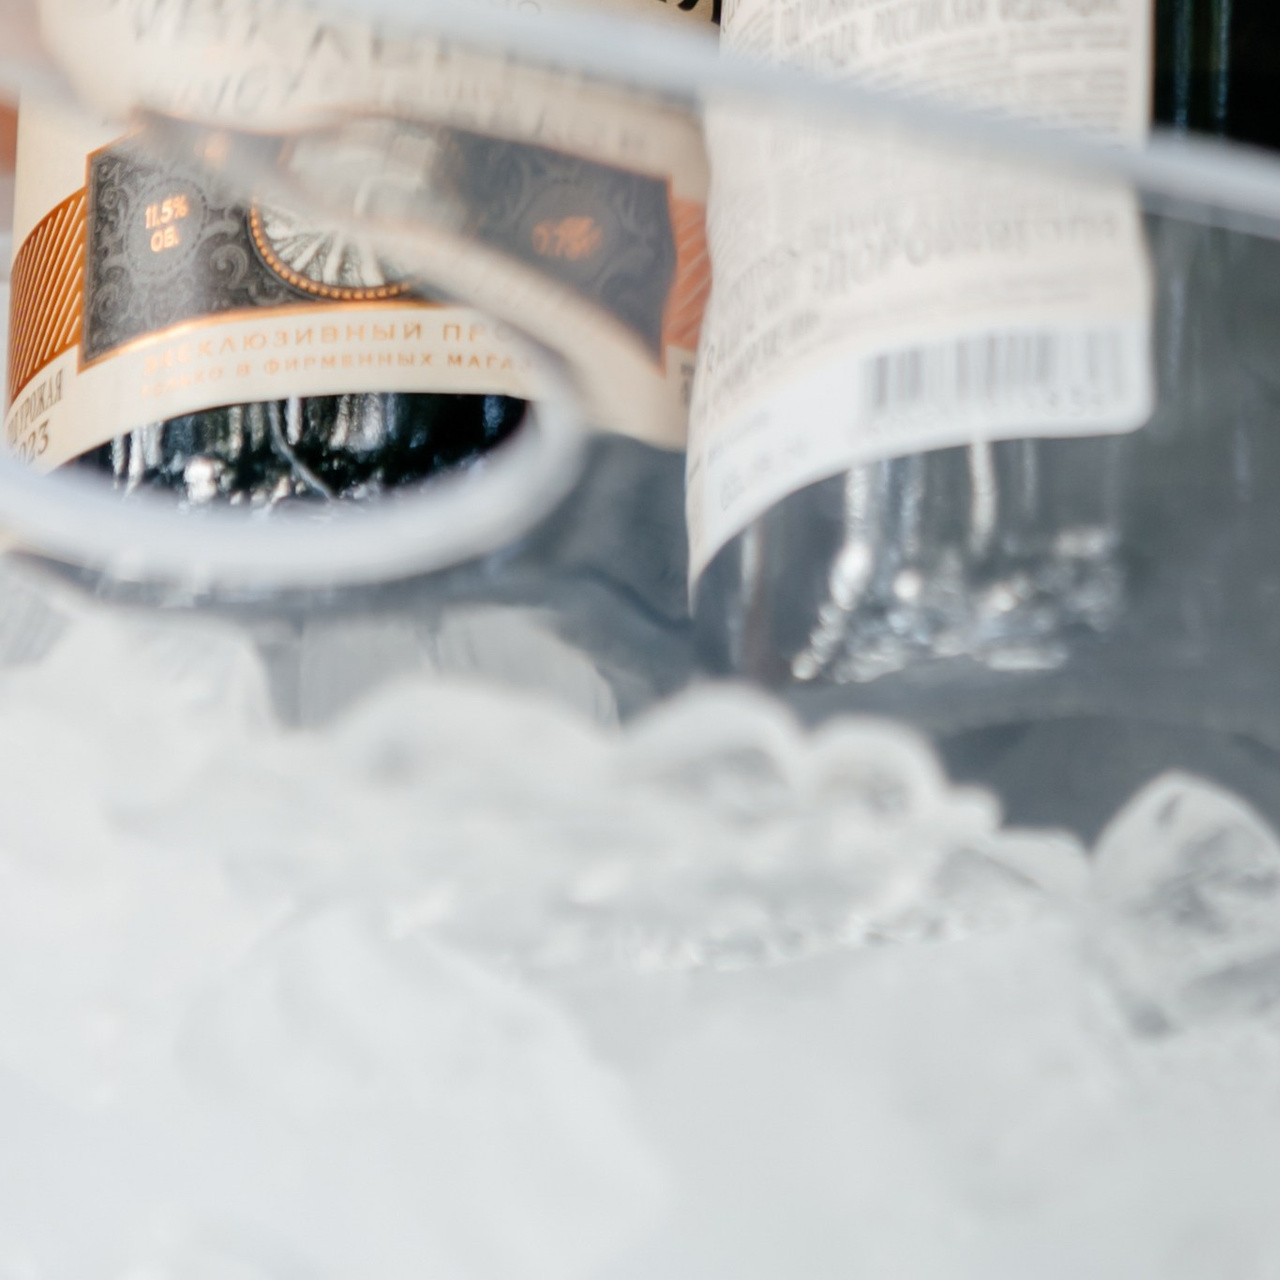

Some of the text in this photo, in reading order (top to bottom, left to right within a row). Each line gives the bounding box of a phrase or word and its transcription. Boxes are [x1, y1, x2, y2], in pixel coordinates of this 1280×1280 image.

[143, 321, 422, 377] ЭКСКЛЮЗИВНЫЙ
[263, 352, 434, 377] ФИРМЕННЫХ
[17, 418, 49, 466] 023
